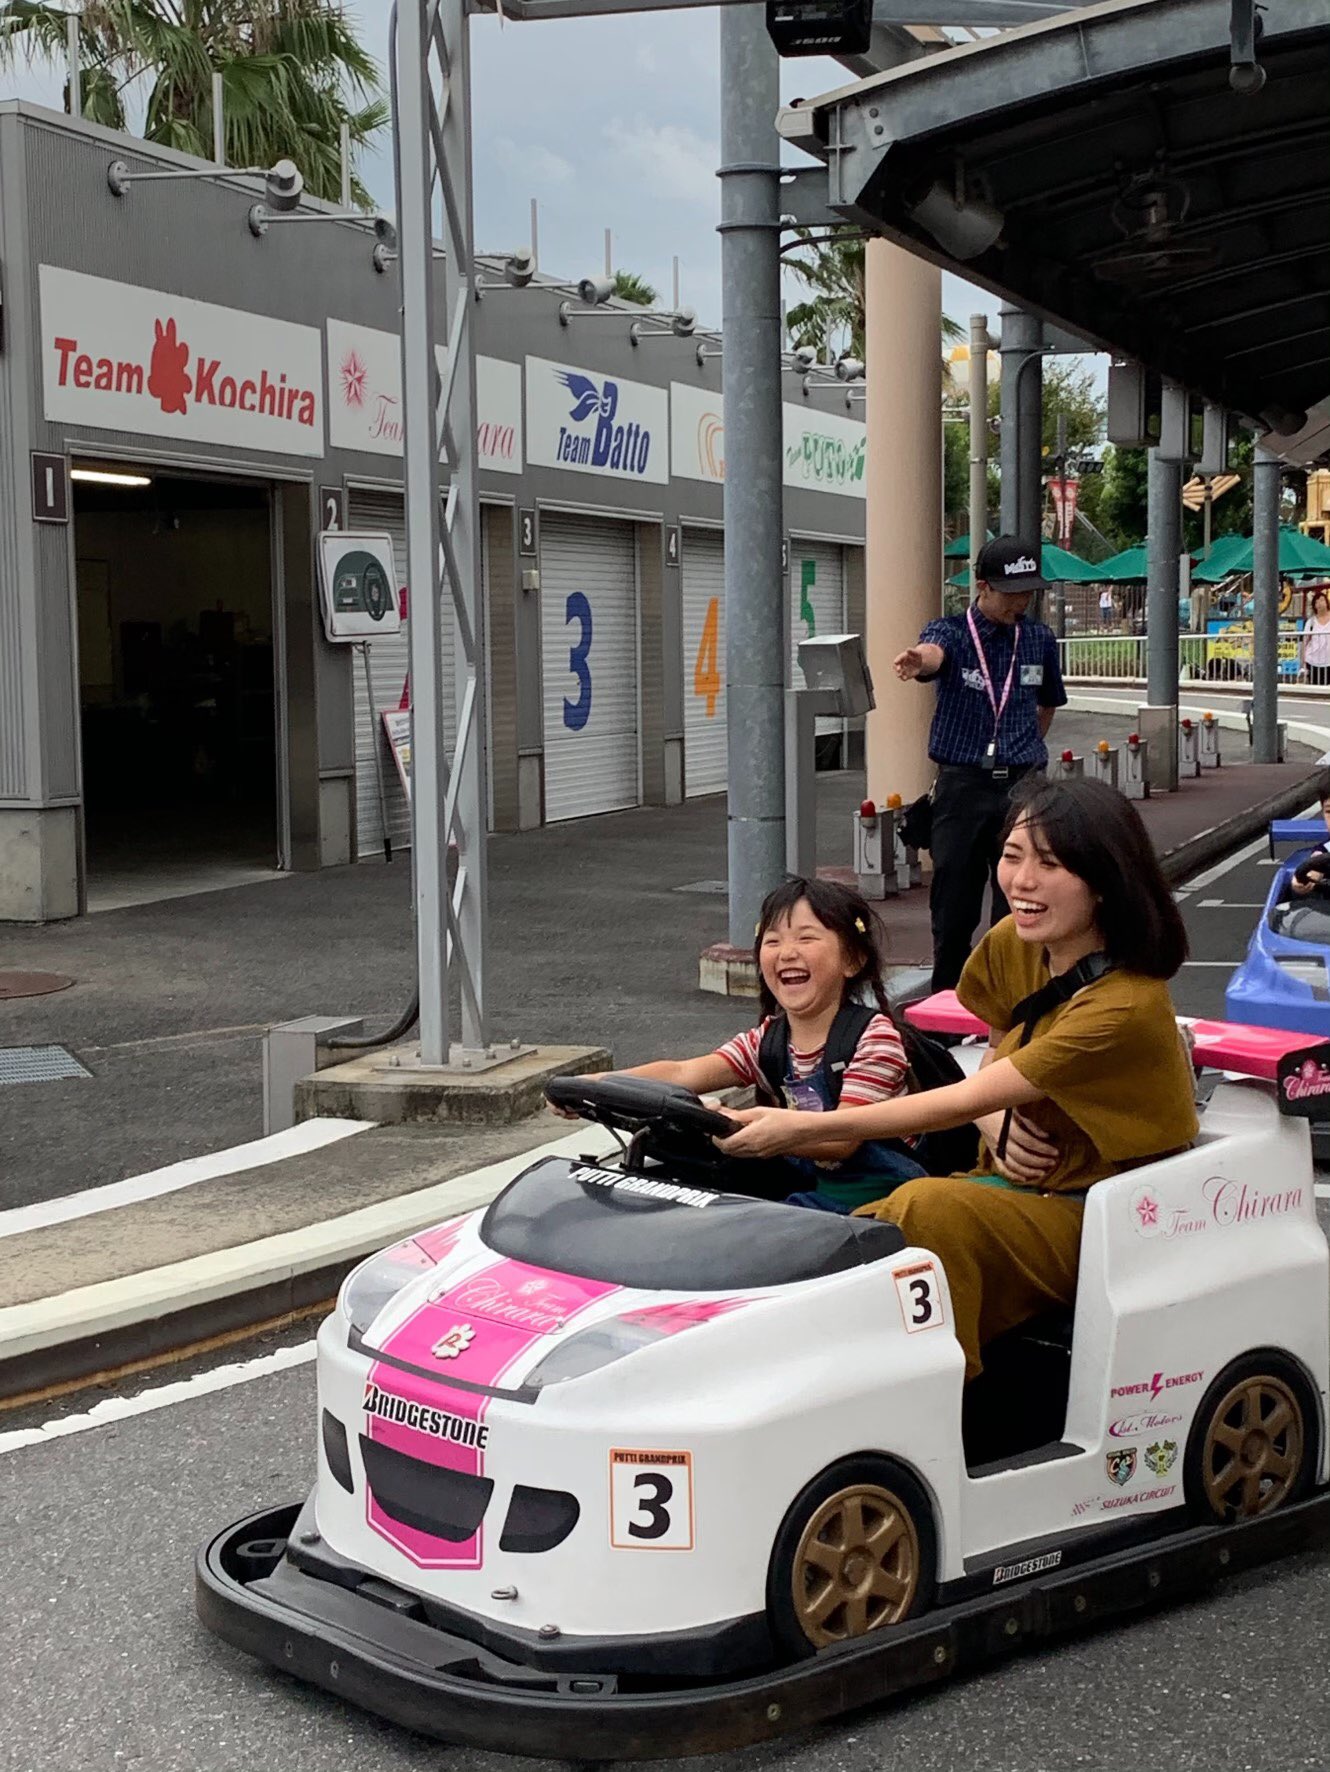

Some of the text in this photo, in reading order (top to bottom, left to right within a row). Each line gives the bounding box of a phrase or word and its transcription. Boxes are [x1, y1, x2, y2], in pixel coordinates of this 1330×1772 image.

[54, 336, 315, 426] Team Kochira
[556, 426, 591, 465] Team
[591, 380, 650, 475] Batto
[326, 496, 338, 531] 2
[523, 517, 533, 546] 3
[668, 533, 677, 558] 4
[563, 591, 592, 731] 3
[694, 597, 720, 718] 4
[1162, 1176, 1302, 1240] Team Chirara
[909, 1279, 932, 1324] 3
[1111, 1371, 1204, 1398] POWER ENERGY
[362, 1384, 489, 1449] BRIDGESTONE
[614, 1452, 687, 1464] PUTTI GRANDPRIX
[628, 1472, 673, 1539] 3
[1100, 1485, 1177, 1510] SUZUKA CIRCUIT
[995, 1552, 1061, 1583] BRIDGESTONE
